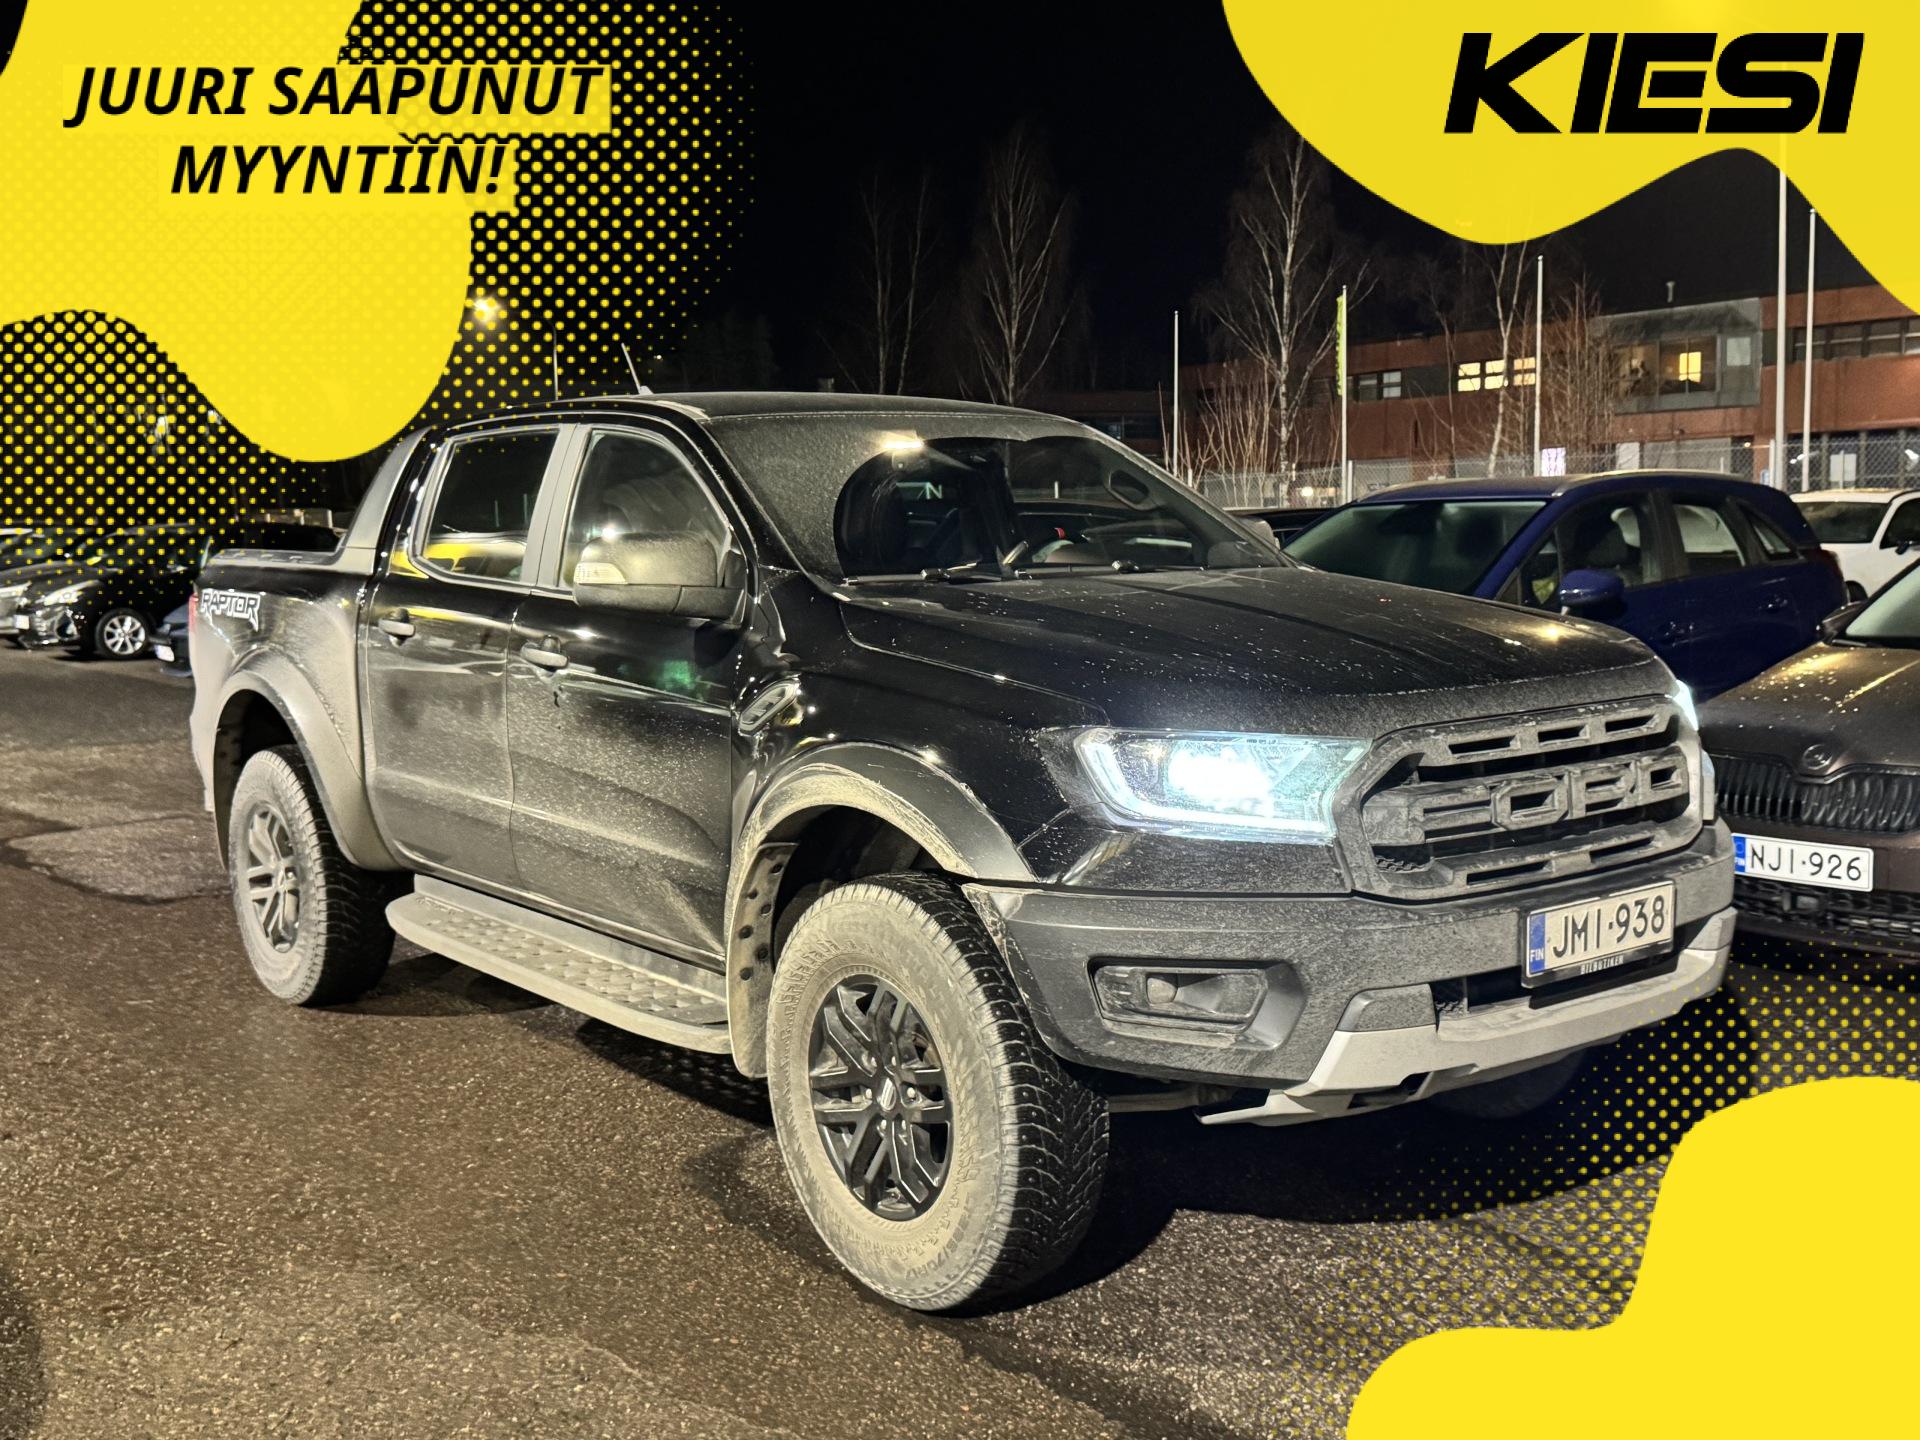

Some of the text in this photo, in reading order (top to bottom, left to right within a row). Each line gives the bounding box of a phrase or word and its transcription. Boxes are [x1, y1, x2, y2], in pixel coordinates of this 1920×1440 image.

[200, 588, 260, 632] RAPTOR
[1402, 748, 1688, 844] FORD
[1751, 844, 1862, 881] NJI-926
[1552, 895, 1665, 958] JMI-938
[1530, 948, 1545, 963] FIN
